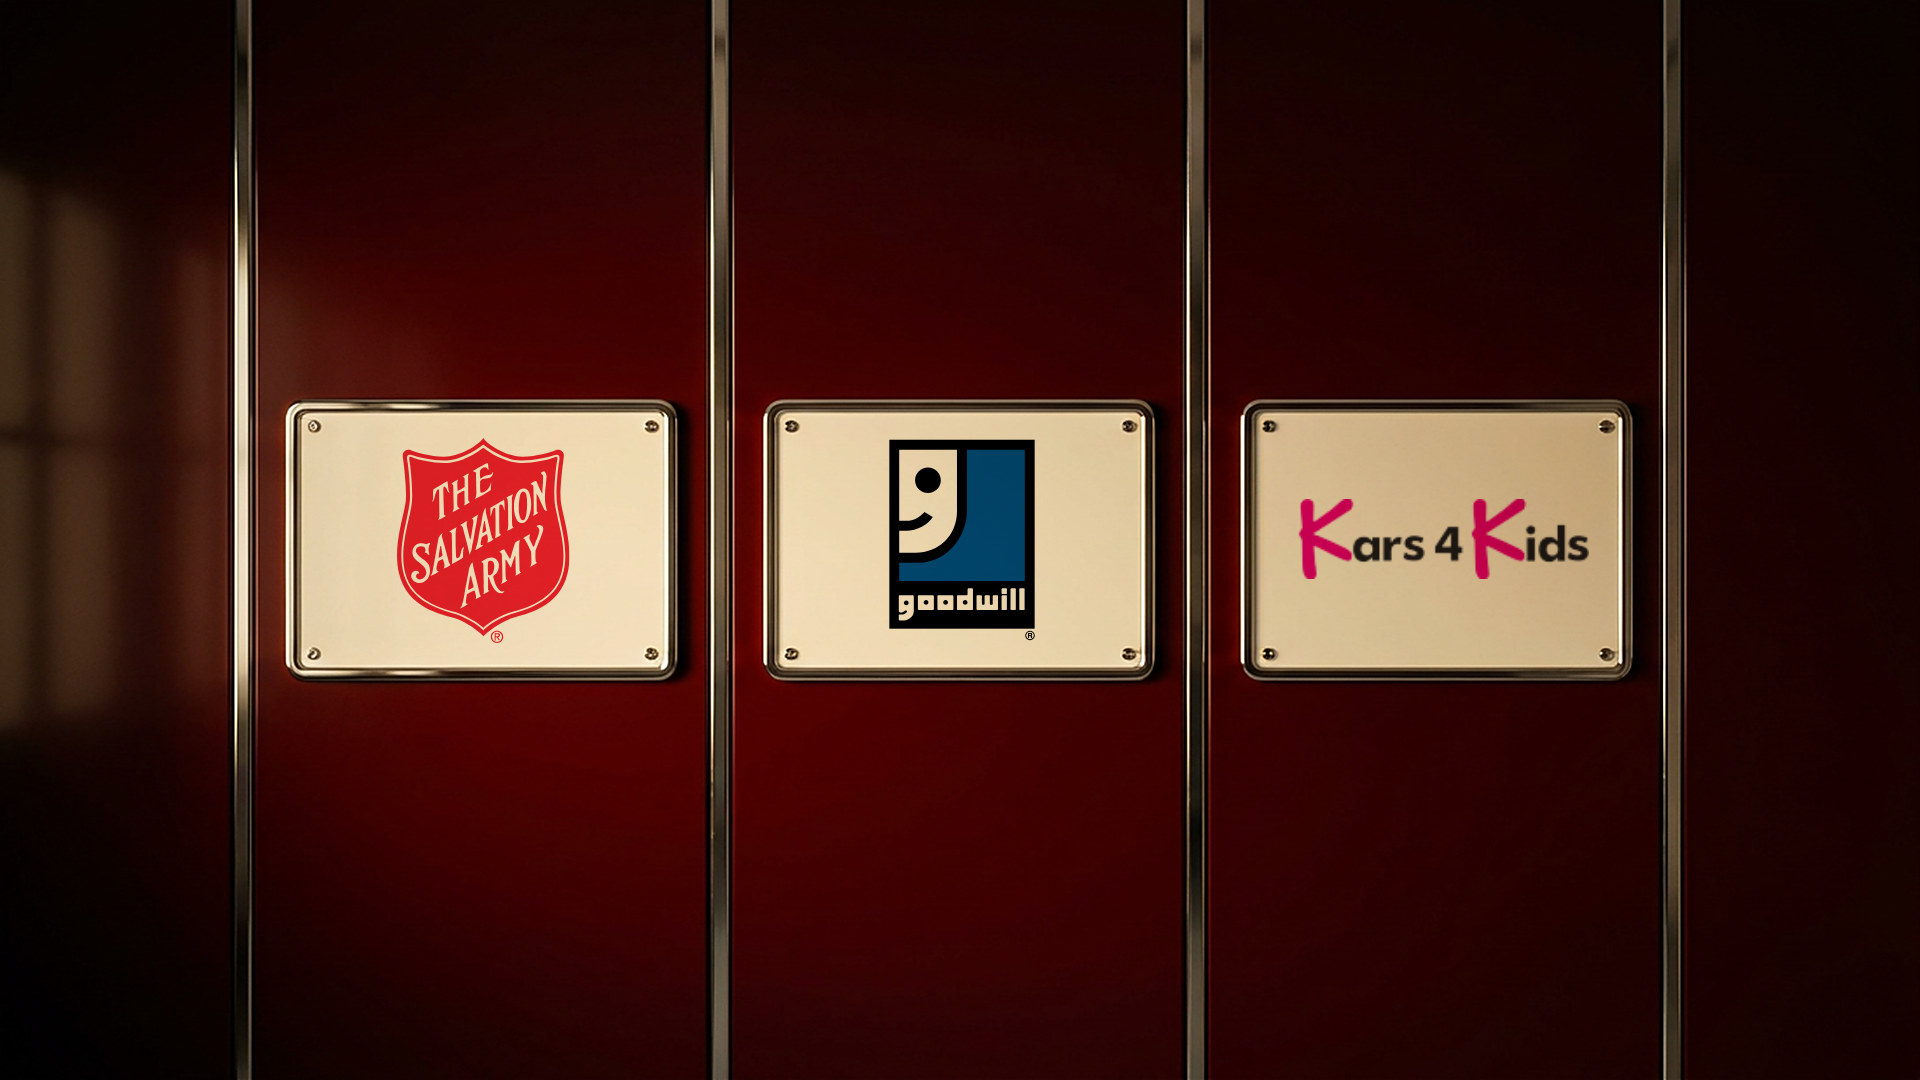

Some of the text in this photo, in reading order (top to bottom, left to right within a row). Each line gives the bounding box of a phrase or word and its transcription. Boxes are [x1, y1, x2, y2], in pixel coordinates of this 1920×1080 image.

[411, 471, 547, 583] SALVATION
[432, 463, 493, 520] THE
[460, 525, 544, 609] ARMY
[1299, 498, 1590, 579] Kars 4 Kids
[898, 588, 1026, 621] goodwill
